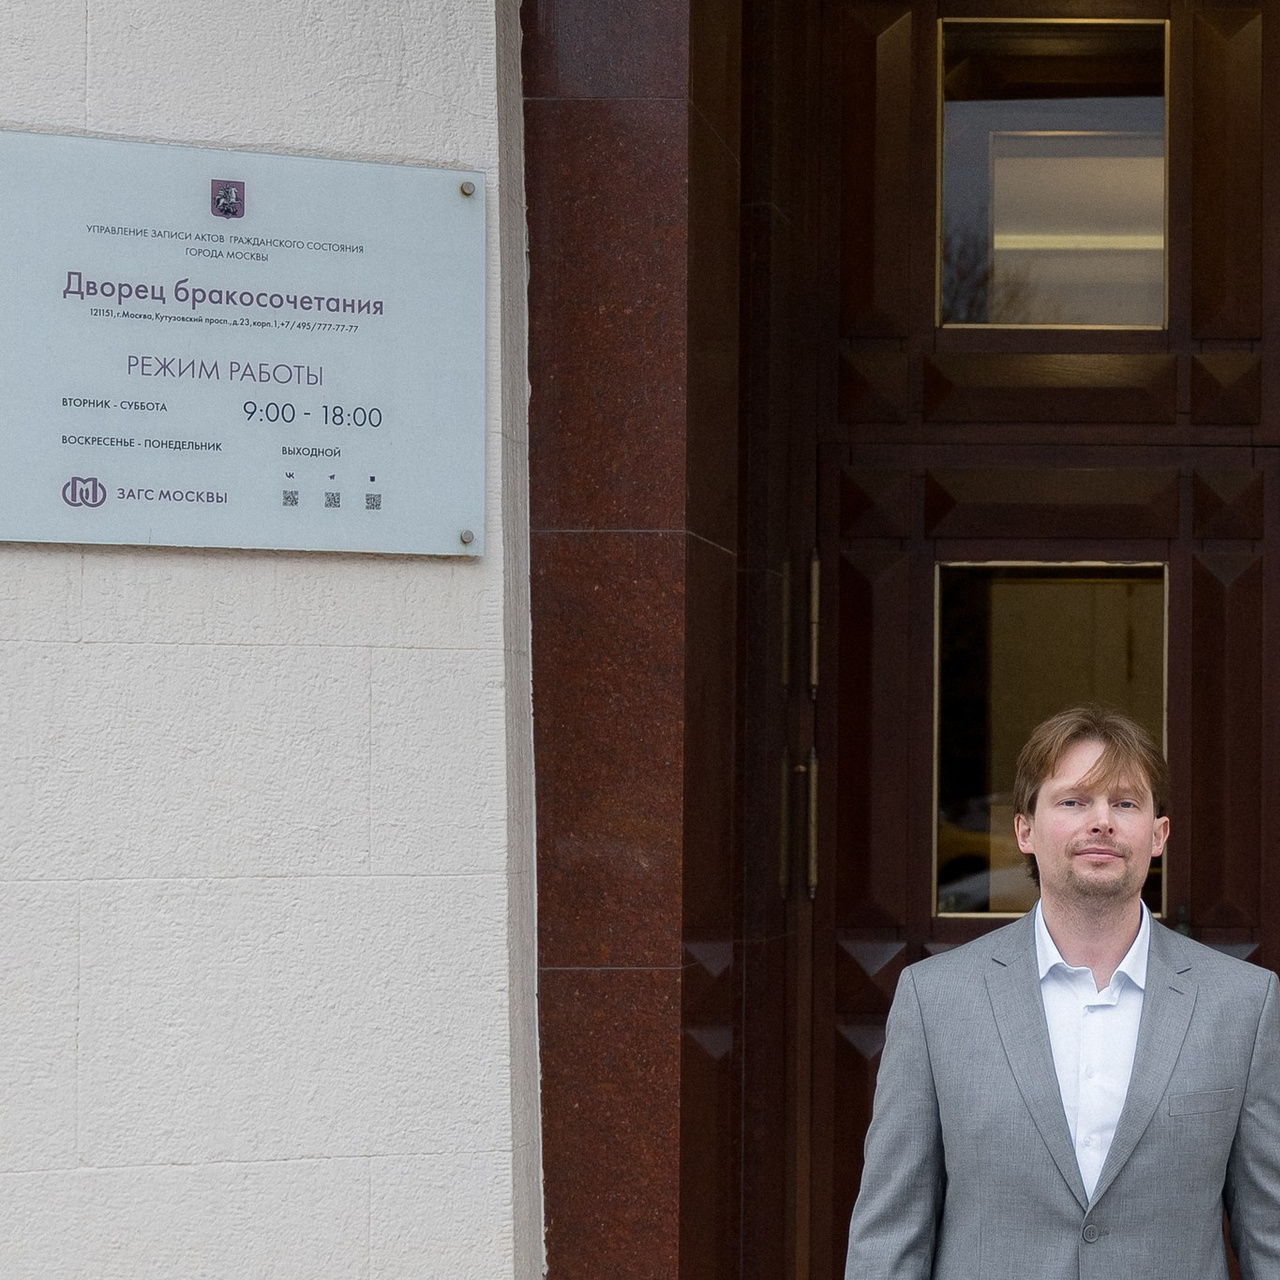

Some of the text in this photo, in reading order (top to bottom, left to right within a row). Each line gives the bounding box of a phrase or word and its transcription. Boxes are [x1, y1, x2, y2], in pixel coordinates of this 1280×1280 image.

[86, 225, 364, 253] УПРАВЛЕНИЕ ЗАПИСИ АКТОВ ГРАЖДАНСКОГО СОСТОЯНИЯ
[185, 247, 269, 261] ГОРОДА МОСКВЫ
[63, 271, 384, 315] Дворец бракосочетания
[128, 355, 323, 386] РЕЖИМ РАБОТЫ
[62, 398, 111, 409] ВТОРНИК
[120, 400, 168, 412] СУББОТА
[243, 401, 296, 423] 9:00
[322, 405, 382, 427] 18:00
[61, 435, 135, 447] ВОСКРЕСЕНЬЕ
[144, 439, 222, 451] ПОНЕДЕЛЬНИК
[281, 446, 341, 458] ВЫХОДНОЙ
[117, 487, 228, 504] ЗАГС МОСКВЫ
